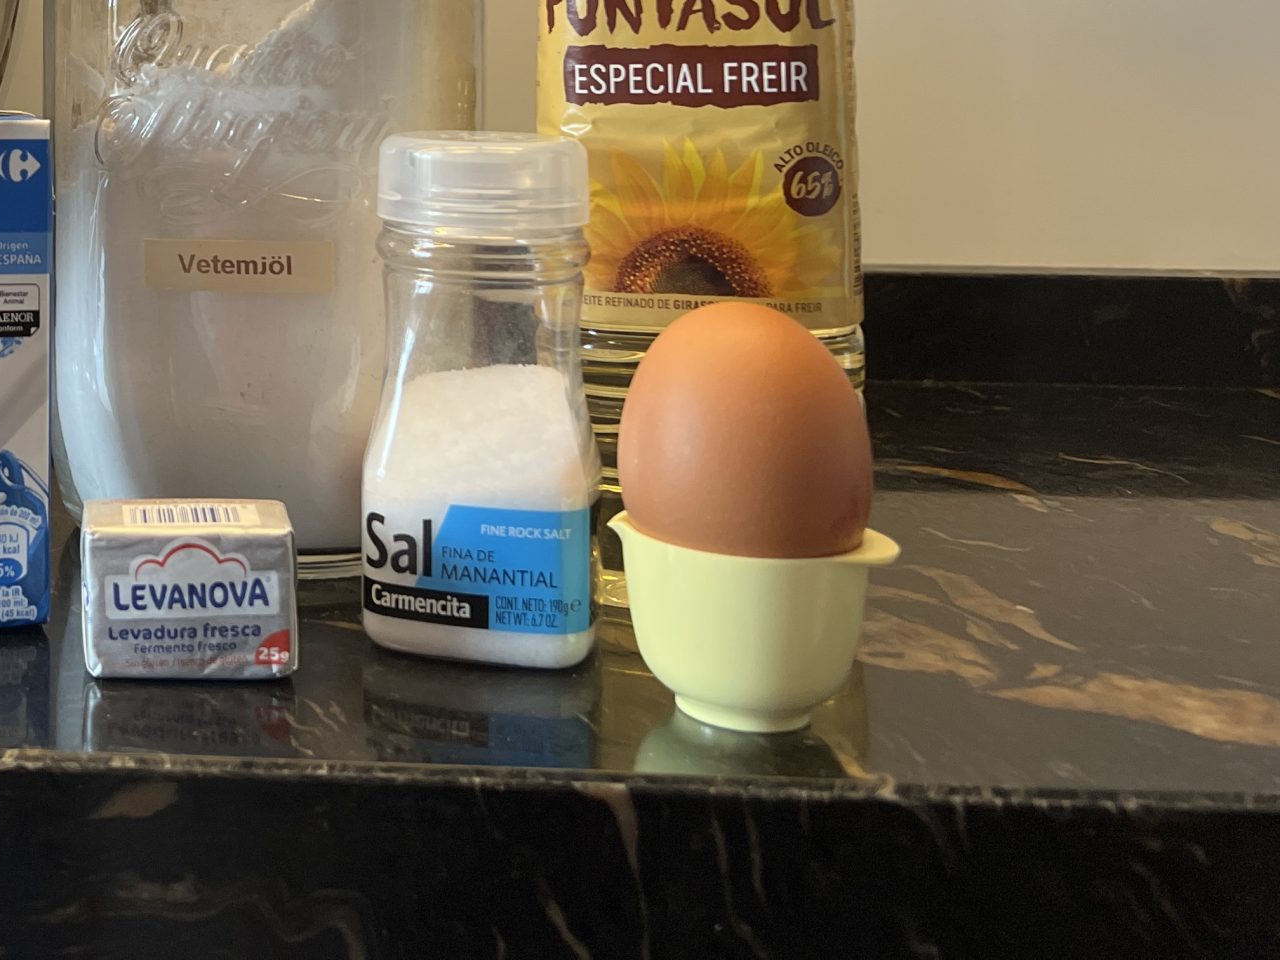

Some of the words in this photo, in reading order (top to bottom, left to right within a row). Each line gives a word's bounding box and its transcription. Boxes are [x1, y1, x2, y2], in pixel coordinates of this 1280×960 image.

[574, 63, 713, 94] ESPECIAL
[723, 62, 808, 93] FREIR
[774, 144, 803, 173] ALTO
[806, 142, 844, 171] OLEICO
[790, 171, 834, 199] 65%
[178, 254, 292, 276] Vetemjöl
[0, 291, 28, 299] Bienestar
[584, 296, 603, 307] EITE
[605, 297, 654, 309] REFINADO
[657, 299, 670, 309] DE
[481, 524, 507, 537] FINE
[508, 527, 541, 538] ROCK
[543, 528, 572, 539] SALT
[3, 545, 20, 554] kcal
[366, 512, 432, 577] Sal
[442, 546, 472, 562] FINA
[477, 549, 494, 562] DE
[441, 563, 557, 589] MANANTIAL
[113, 578, 269, 611] LEVANOVA
[371, 584, 470, 619] Carmencita
[495, 611, 512, 625] NET
[109, 624, 197, 640] Levadura
[203, 623, 261, 638] fresca
[134, 643, 194, 654] Fermento
[198, 641, 237, 652] fresco
[259, 647, 289, 662] 25g
